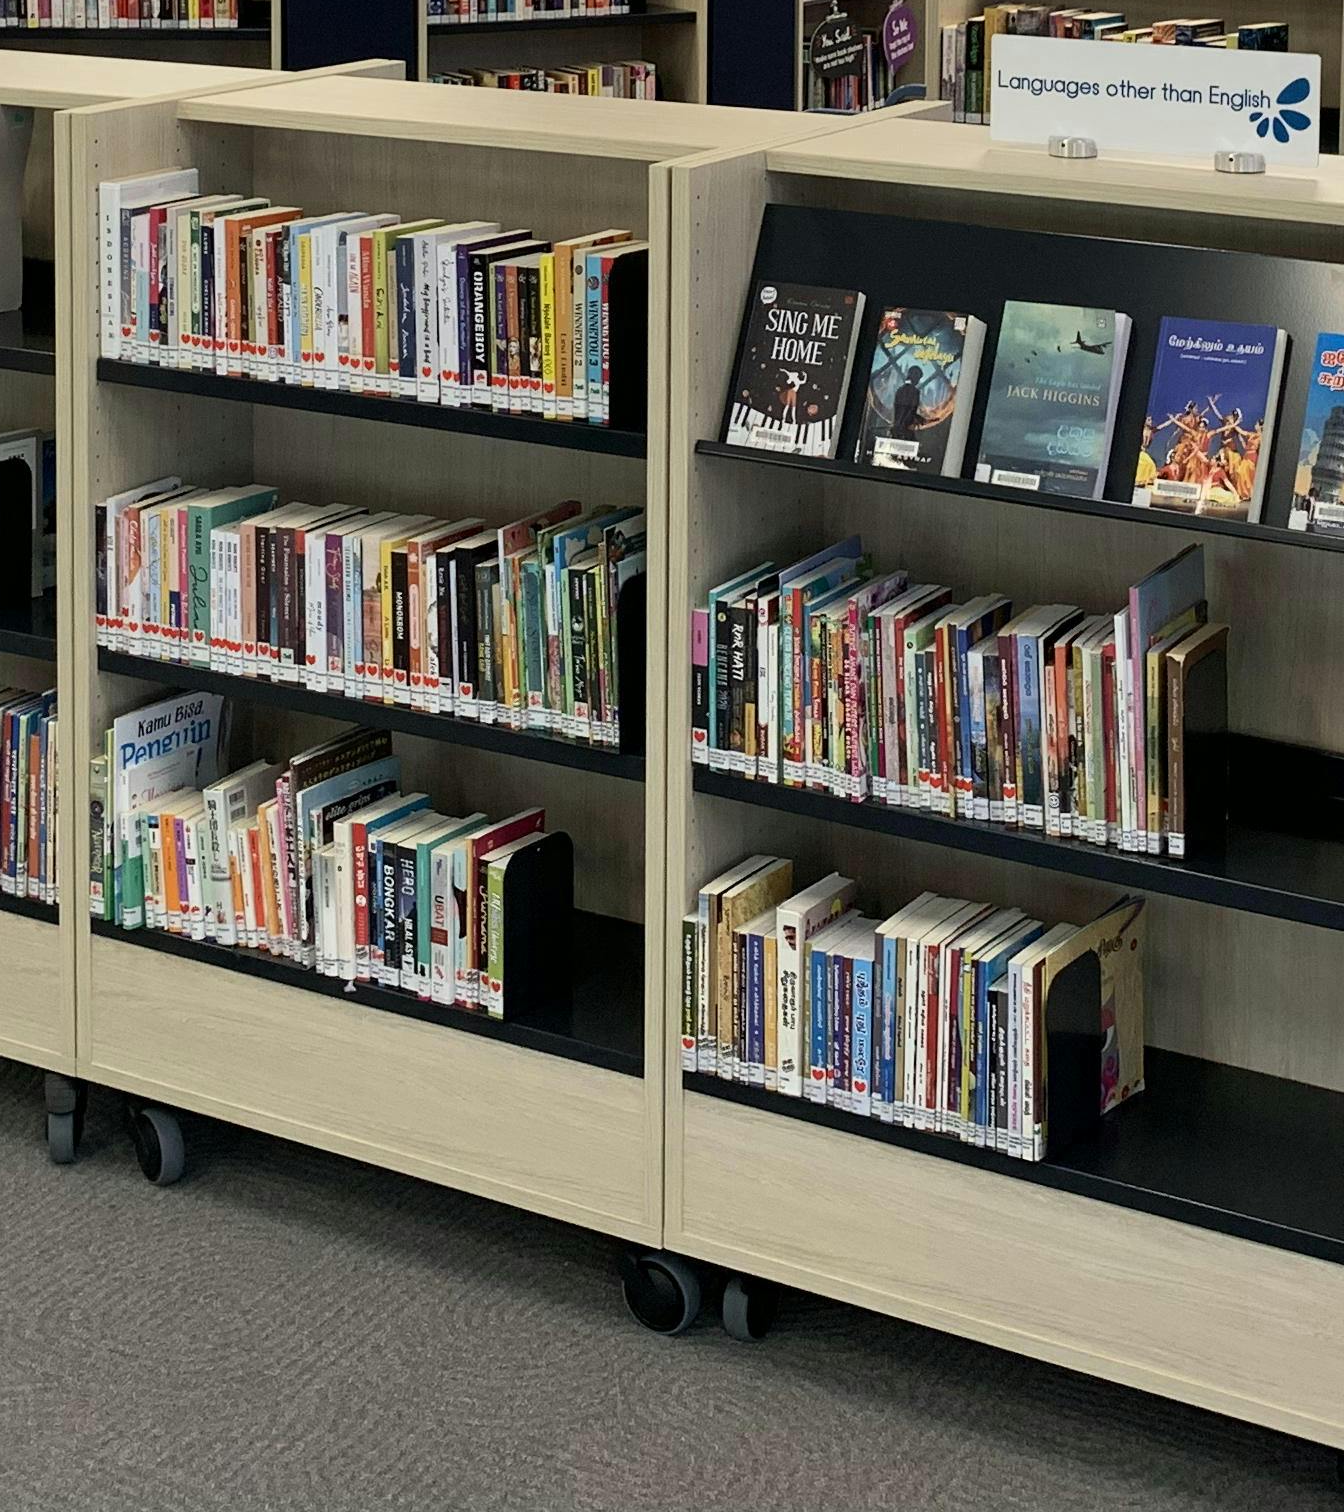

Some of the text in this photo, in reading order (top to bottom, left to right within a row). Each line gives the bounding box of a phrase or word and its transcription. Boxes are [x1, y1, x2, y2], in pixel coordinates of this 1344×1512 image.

[821, 26, 853, 48] You Said
[892, 17, 909, 36] So We
[997, 70, 1272, 112] Languages other than English
[362, 250, 371, 273] Miss
[421, 283, 431, 295] My
[421, 298, 431, 333] Boyfriend
[473, 271, 485, 363] ORANGEBOY
[575, 303, 583, 357] WINNETOU
[589, 299, 599, 367] WINNETOU 3
[765, 308, 843, 340] SING ME
[423, 349, 431, 364] Bad
[771, 336, 827, 366] HOME
[1006, 383, 1101, 408] JACK HIGGINS
[282, 535, 292, 620] The Fountains Silence
[395, 591, 405, 640] MONOKROM
[716, 643, 729, 686] BENCANA
[731, 623, 745, 681] RnR HATI
[137, 700, 204, 738] Kamu Bisa
[325, 793, 372, 822] elite grips
[384, 864, 396, 941] BONGKAR
[400, 858, 415, 942] HERO HILAL
[434, 894, 445, 928] UBAT
